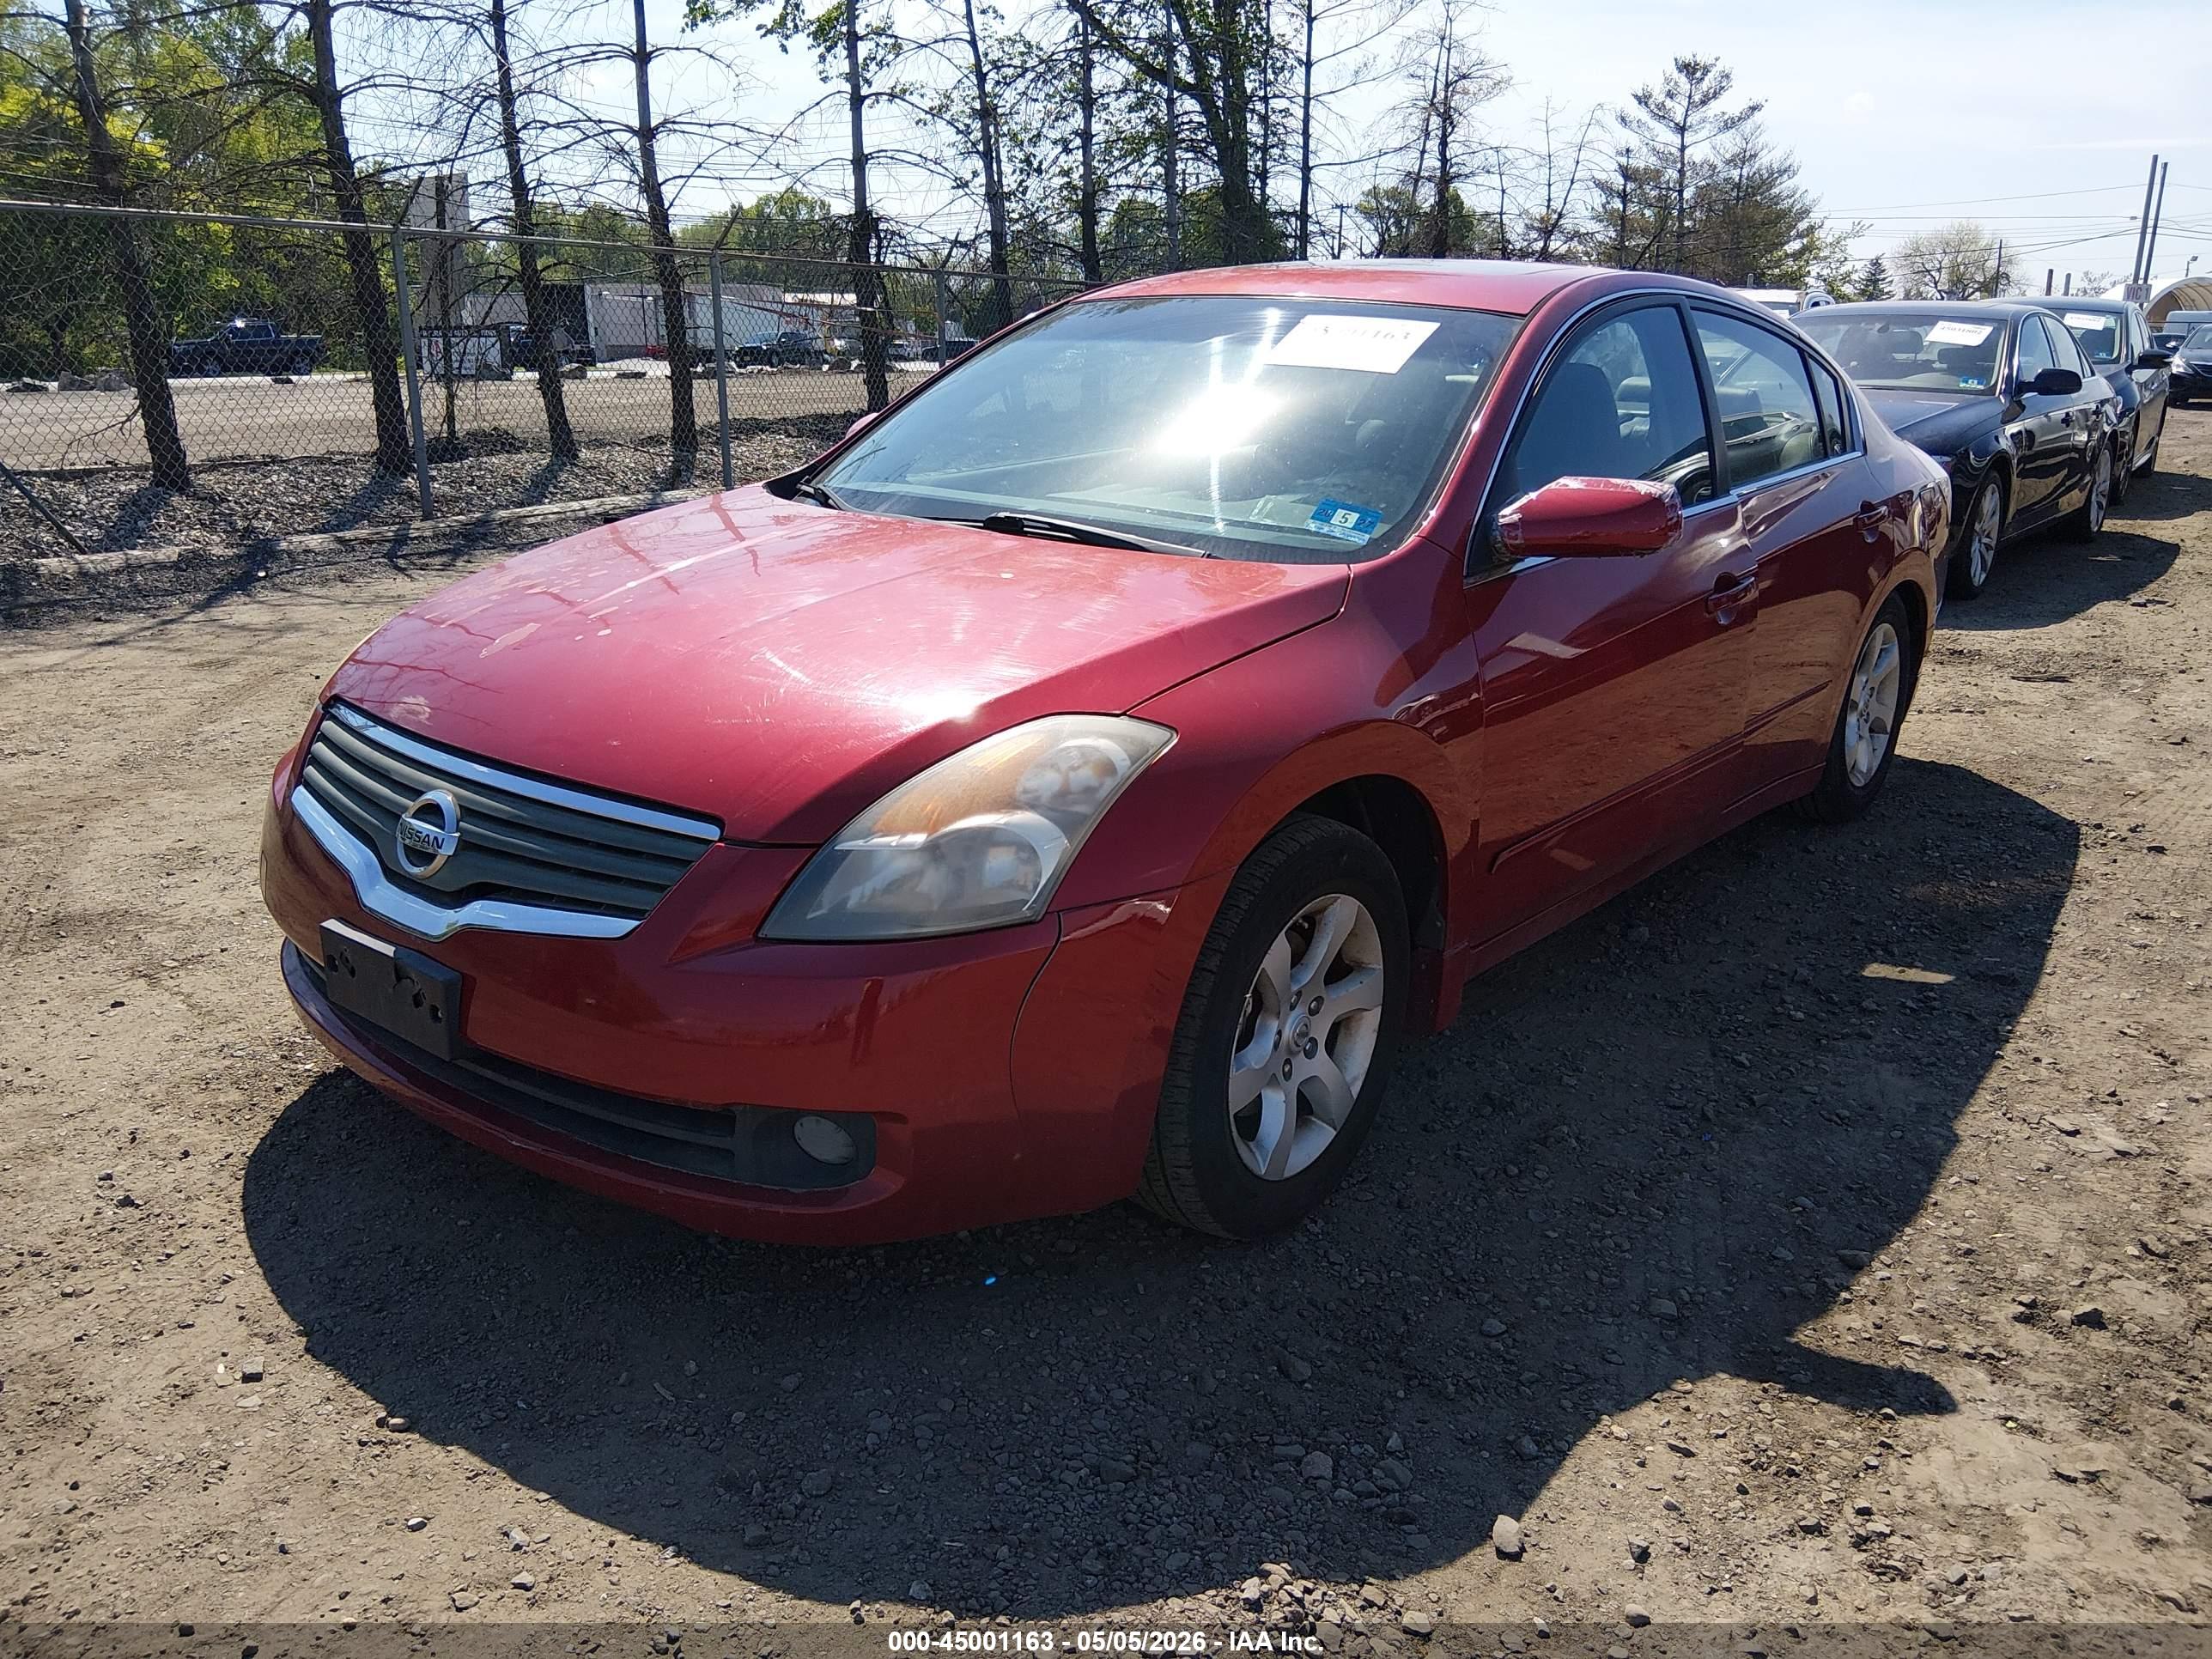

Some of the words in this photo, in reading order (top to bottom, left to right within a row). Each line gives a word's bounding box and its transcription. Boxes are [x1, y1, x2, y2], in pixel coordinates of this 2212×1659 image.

[2126, 287, 2142, 301] VIC
[2145, 287, 2150, 301] 1
[1339, 513, 1352, 525] 5
[398, 823, 446, 850] NISSAN
